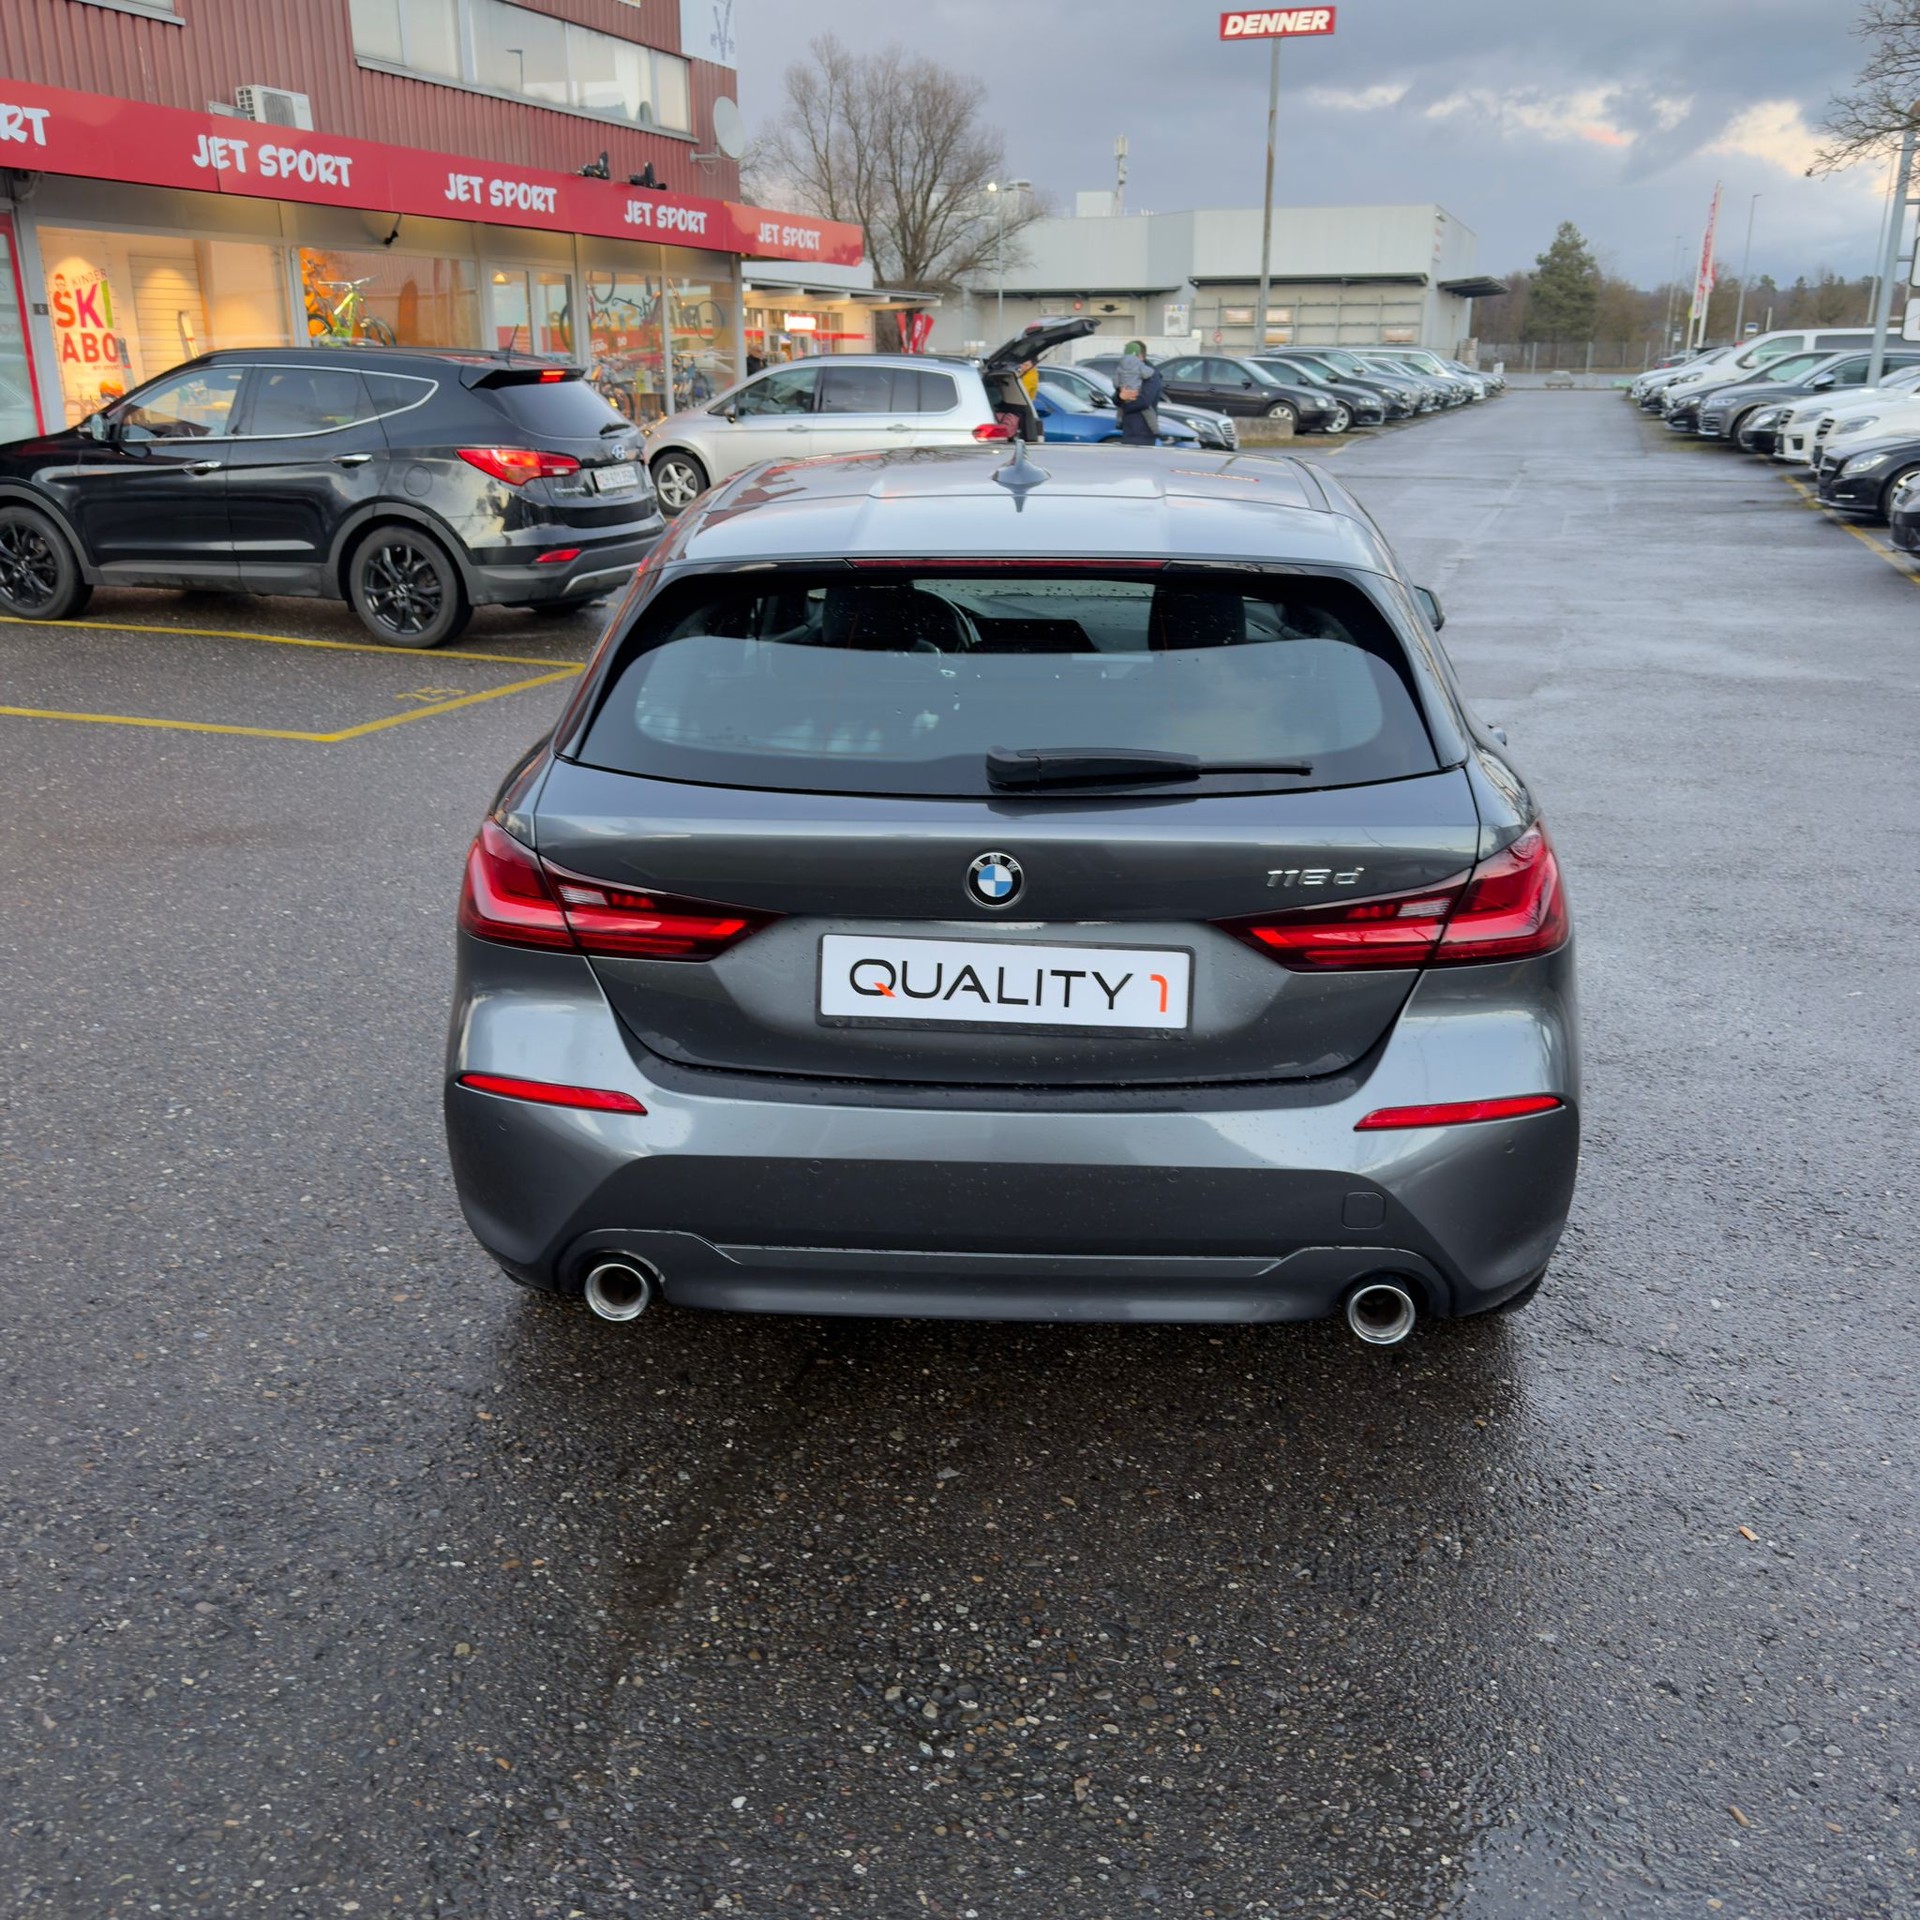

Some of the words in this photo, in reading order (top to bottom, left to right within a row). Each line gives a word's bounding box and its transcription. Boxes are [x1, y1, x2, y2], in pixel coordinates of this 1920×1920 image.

[1224, 9, 1331, 36] DENNER
[192, 134, 249, 173] JET
[258, 144, 353, 188] SPORT
[444, 173, 484, 204] JET
[489, 179, 557, 213] SPORT
[624, 199, 653, 226] JET
[656, 205, 707, 234] SPORT
[758, 222, 779, 245] JET
[782, 226, 821, 251] SPORT
[53, 280, 114, 329] SKI
[63, 332, 119, 363] ABO
[849, 958, 1133, 1010] QUALITY
[1149, 973, 1168, 1013] 1
